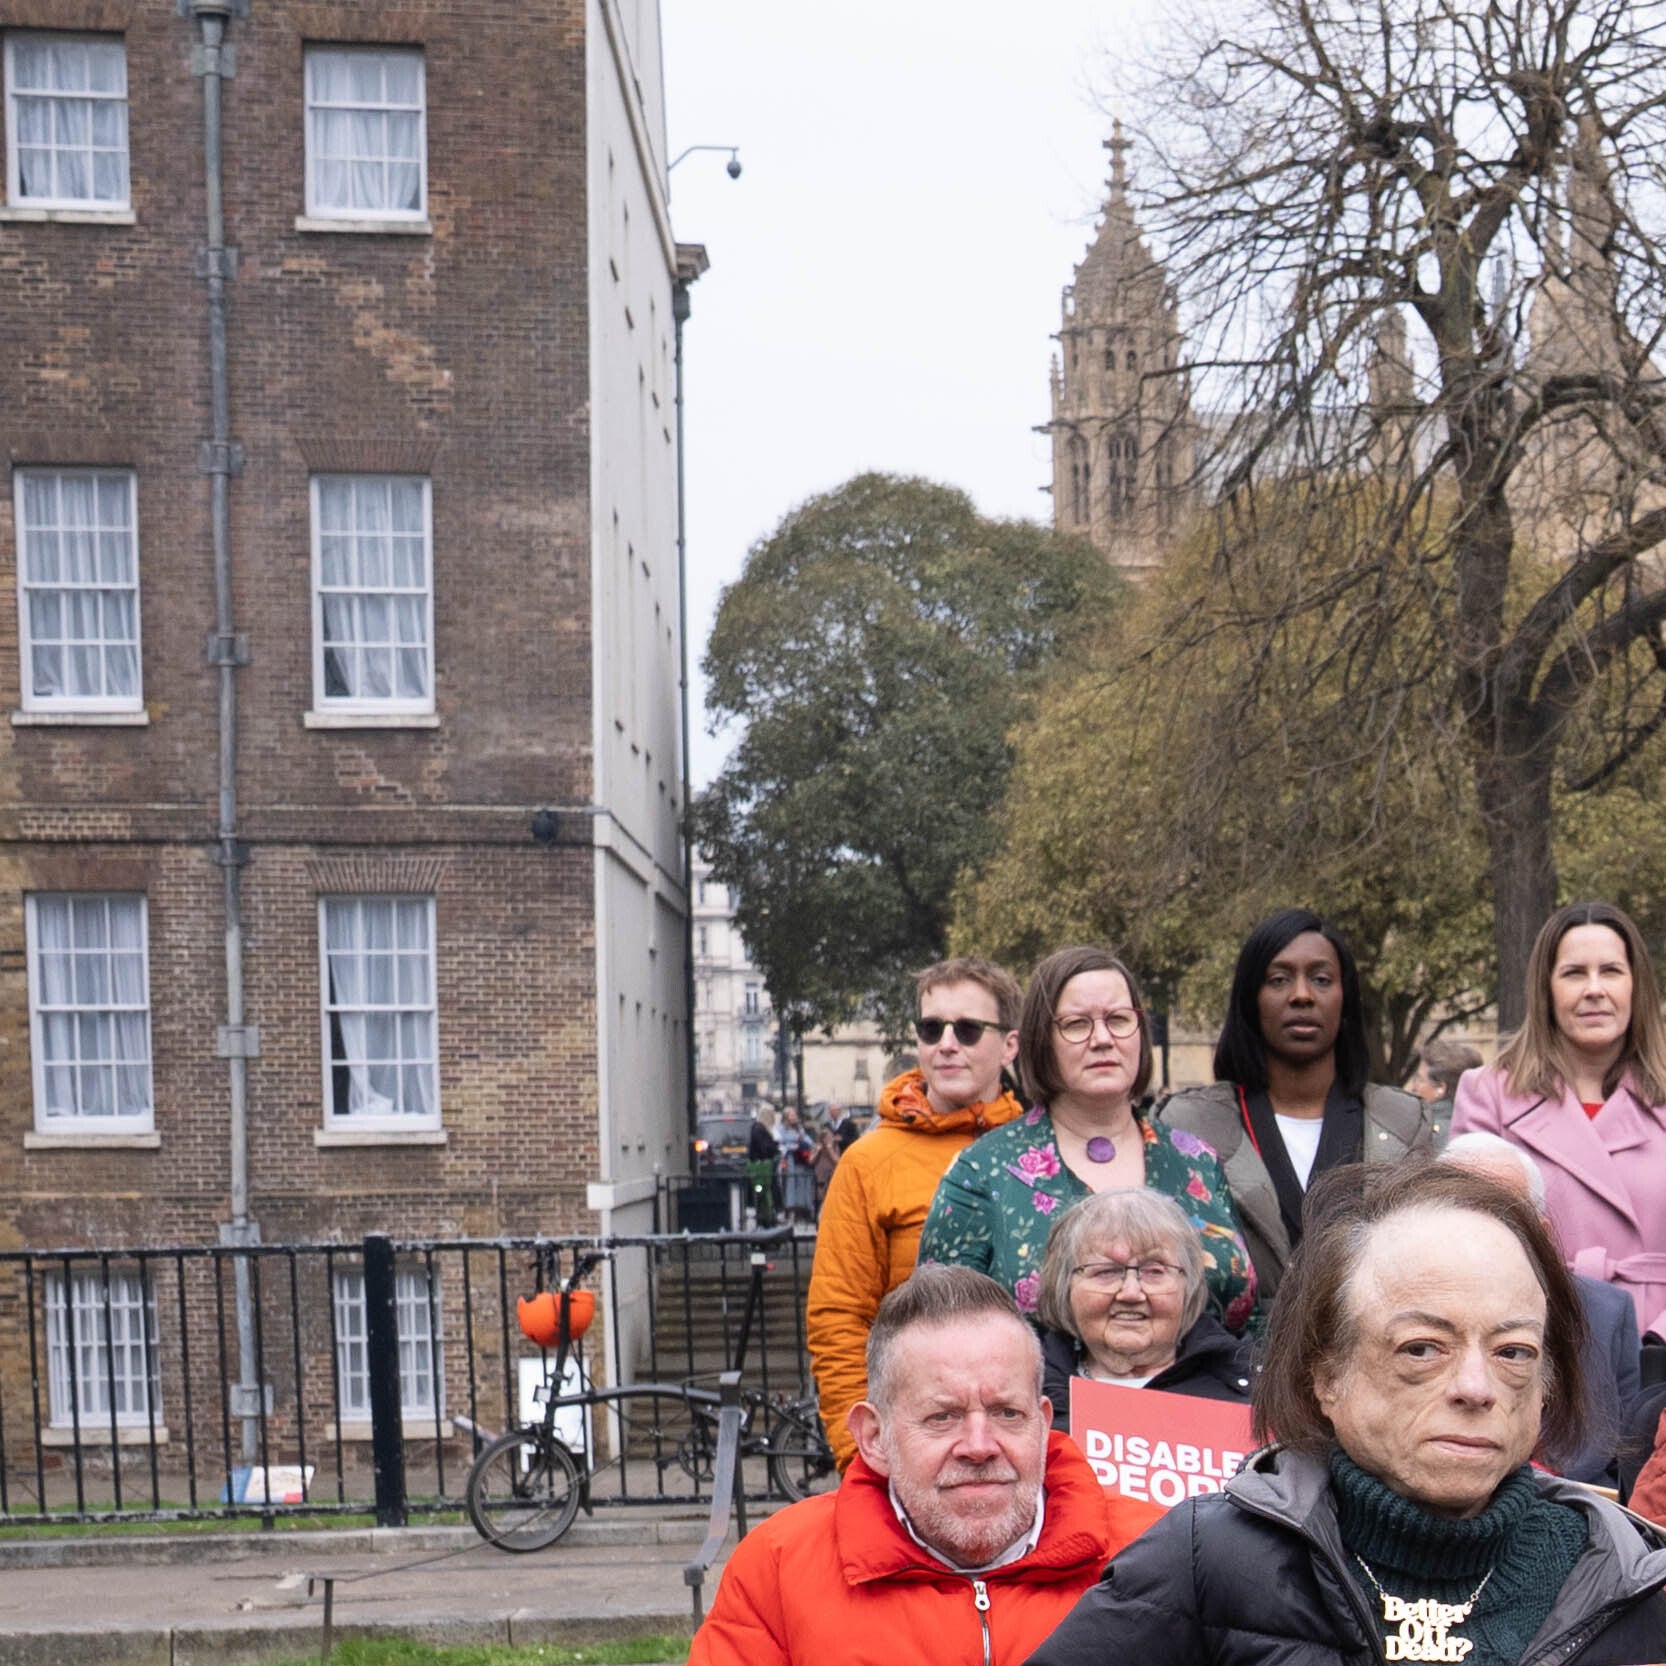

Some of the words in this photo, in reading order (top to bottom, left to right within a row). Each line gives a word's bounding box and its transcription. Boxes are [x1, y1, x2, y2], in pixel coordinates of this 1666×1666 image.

[1086, 1429, 1244, 1479] DISABLE
[1086, 1458, 1229, 1508] PEOP
[1384, 1596, 1472, 1624] Better
[1399, 1618, 1450, 1647] Off
[1385, 1634, 1474, 1662] Dead?
